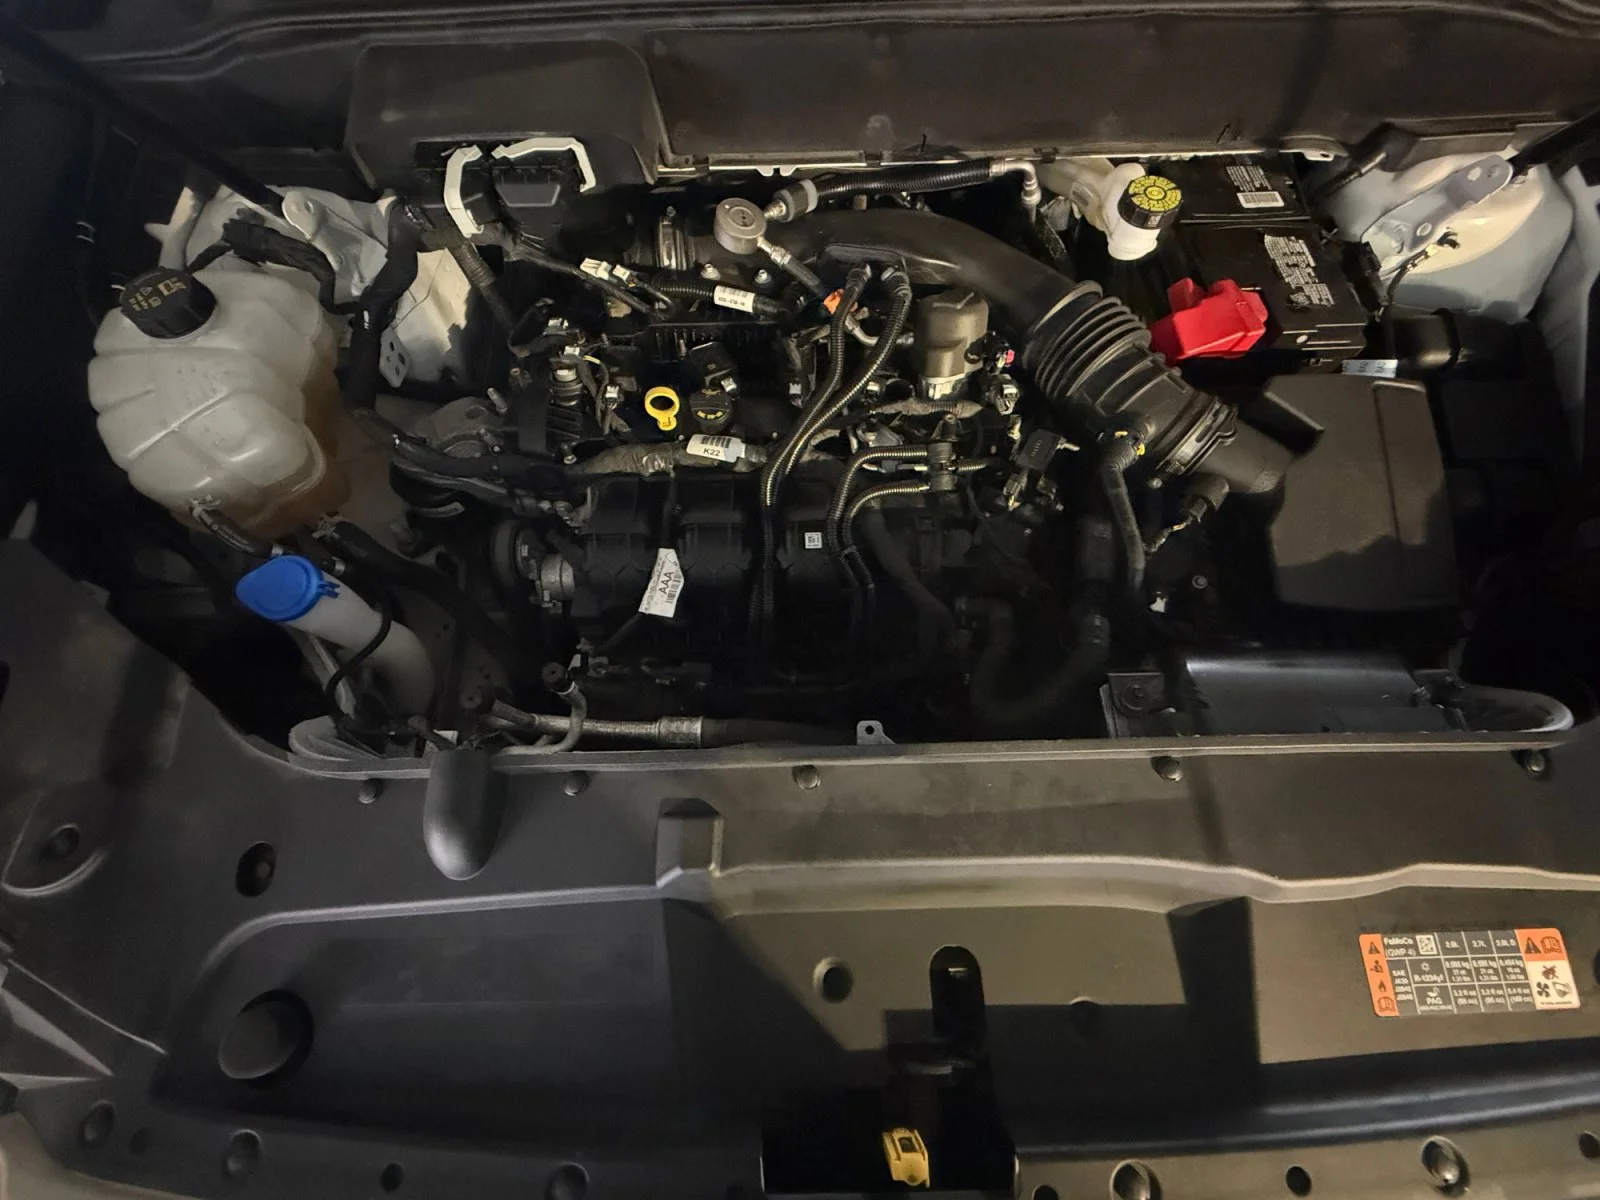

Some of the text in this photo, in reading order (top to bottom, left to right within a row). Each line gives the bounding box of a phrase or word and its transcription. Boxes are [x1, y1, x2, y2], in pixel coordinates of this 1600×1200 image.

[703, 448, 721, 457] K22
[658, 571, 674, 594] AAA
[1386, 949, 1406, 957] (GWP
[1414, 974, 1444, 983] R-1234yf
